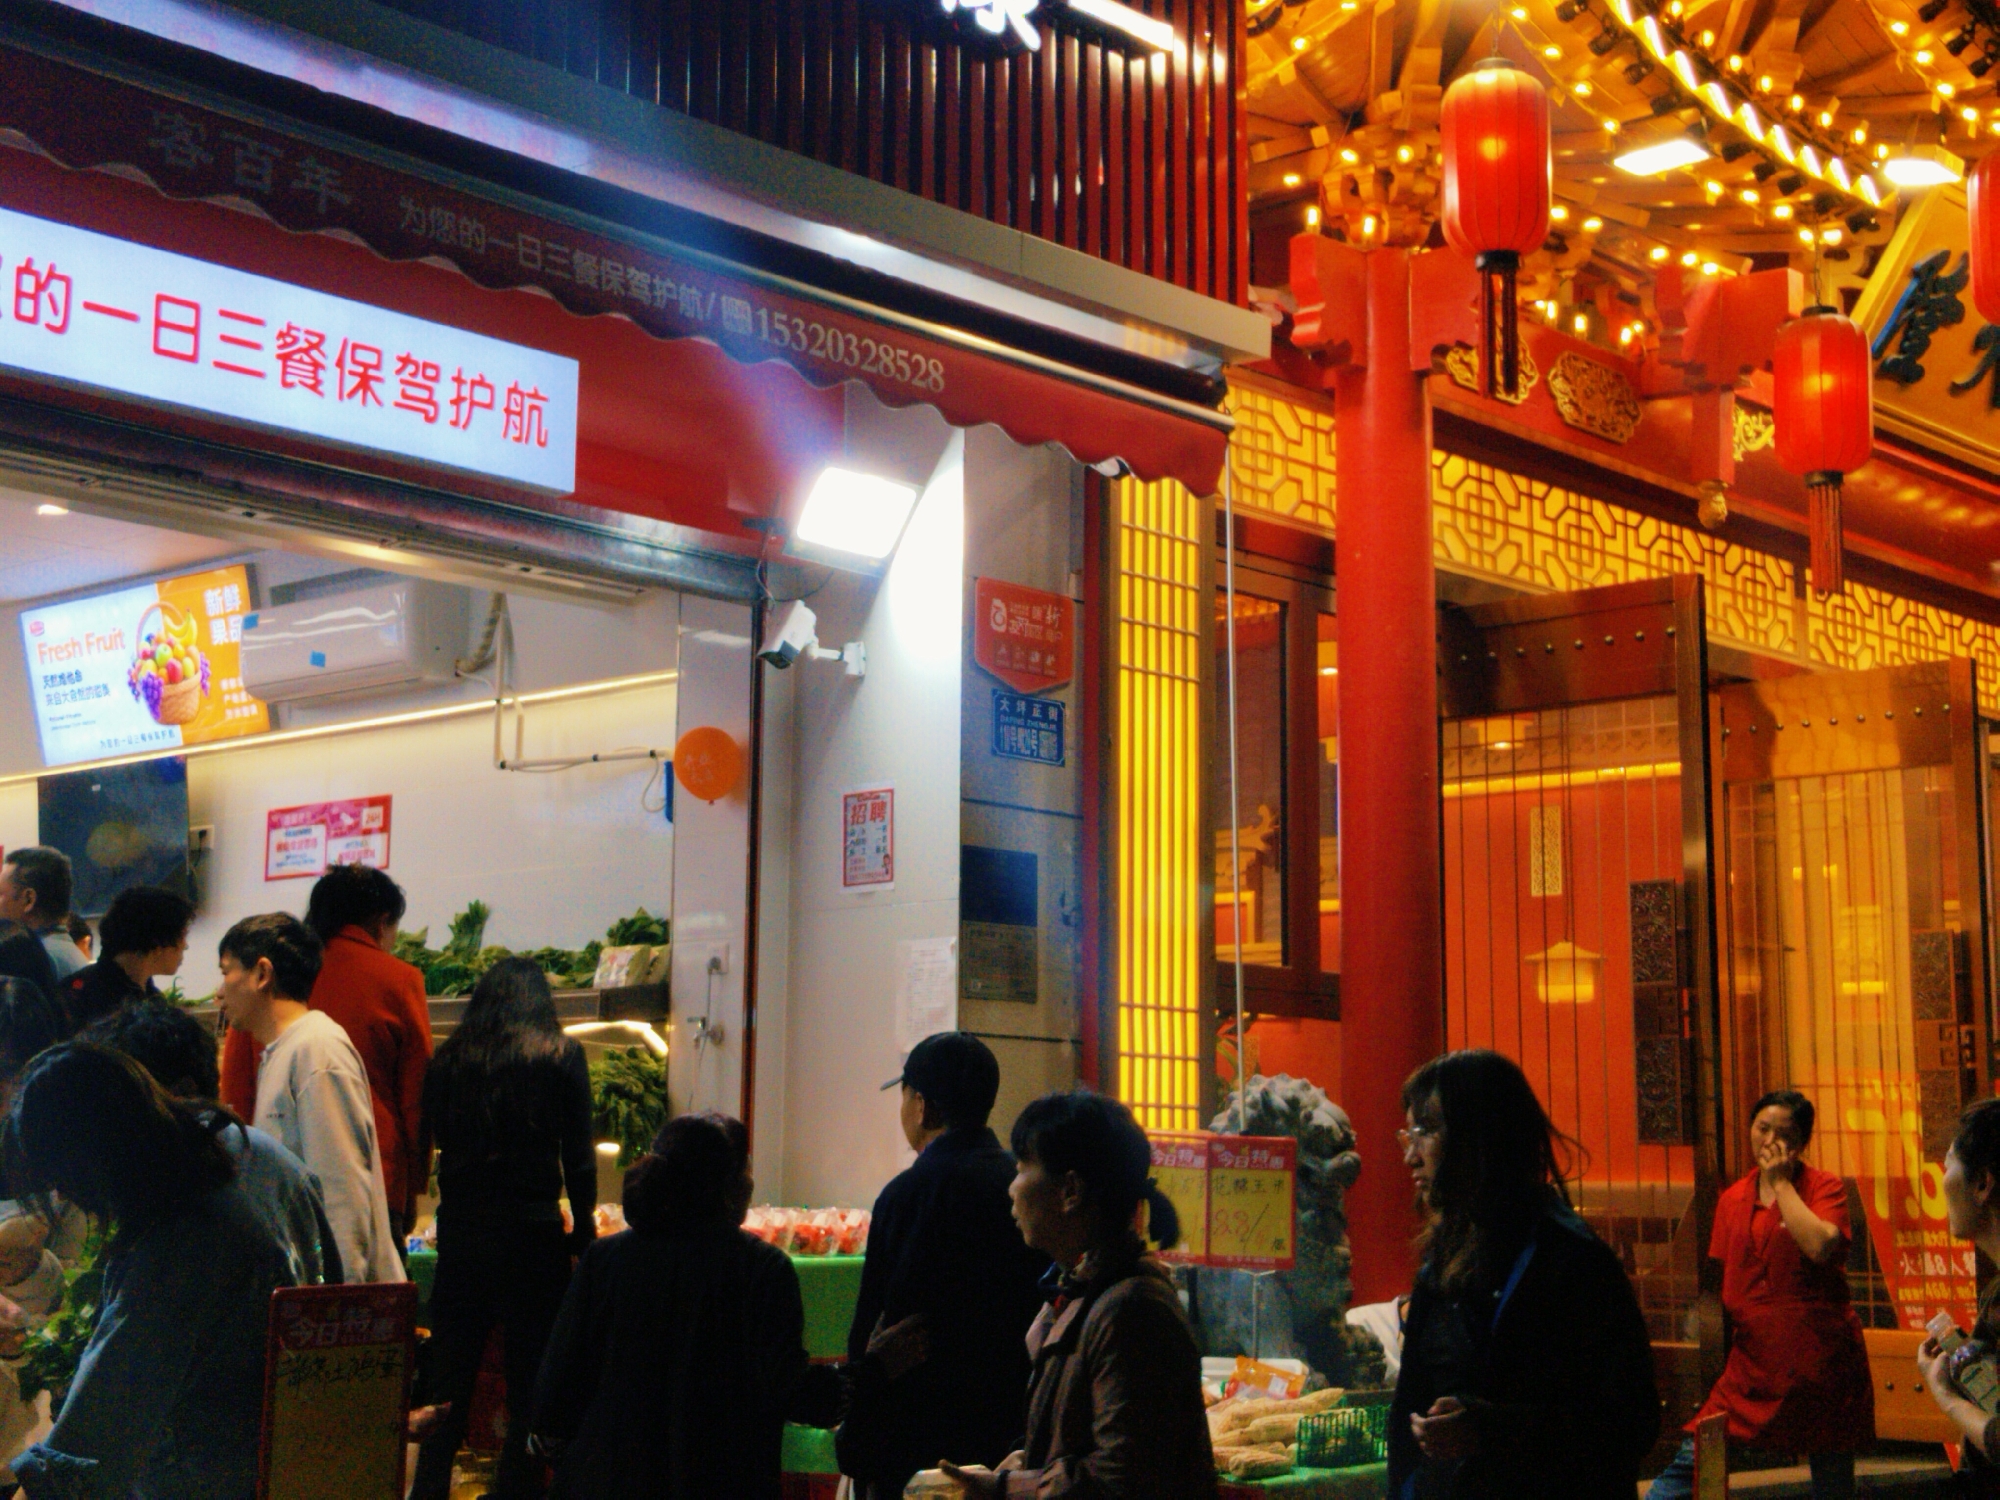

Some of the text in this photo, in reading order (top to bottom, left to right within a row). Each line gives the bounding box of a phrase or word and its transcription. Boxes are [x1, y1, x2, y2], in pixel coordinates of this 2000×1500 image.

[0, 252, 550, 449] 的一日三餐保驾护航
[755, 307, 945, 393] 15320328528
[203, 583, 242, 617] 新鲜
[37, 627, 126, 664] Fresh Fruit
[1000, 696, 1058, 721] 大坪正街
[851, 800, 888, 826] 招聘
[1217, 1149, 1285, 1168] 今日特惠
